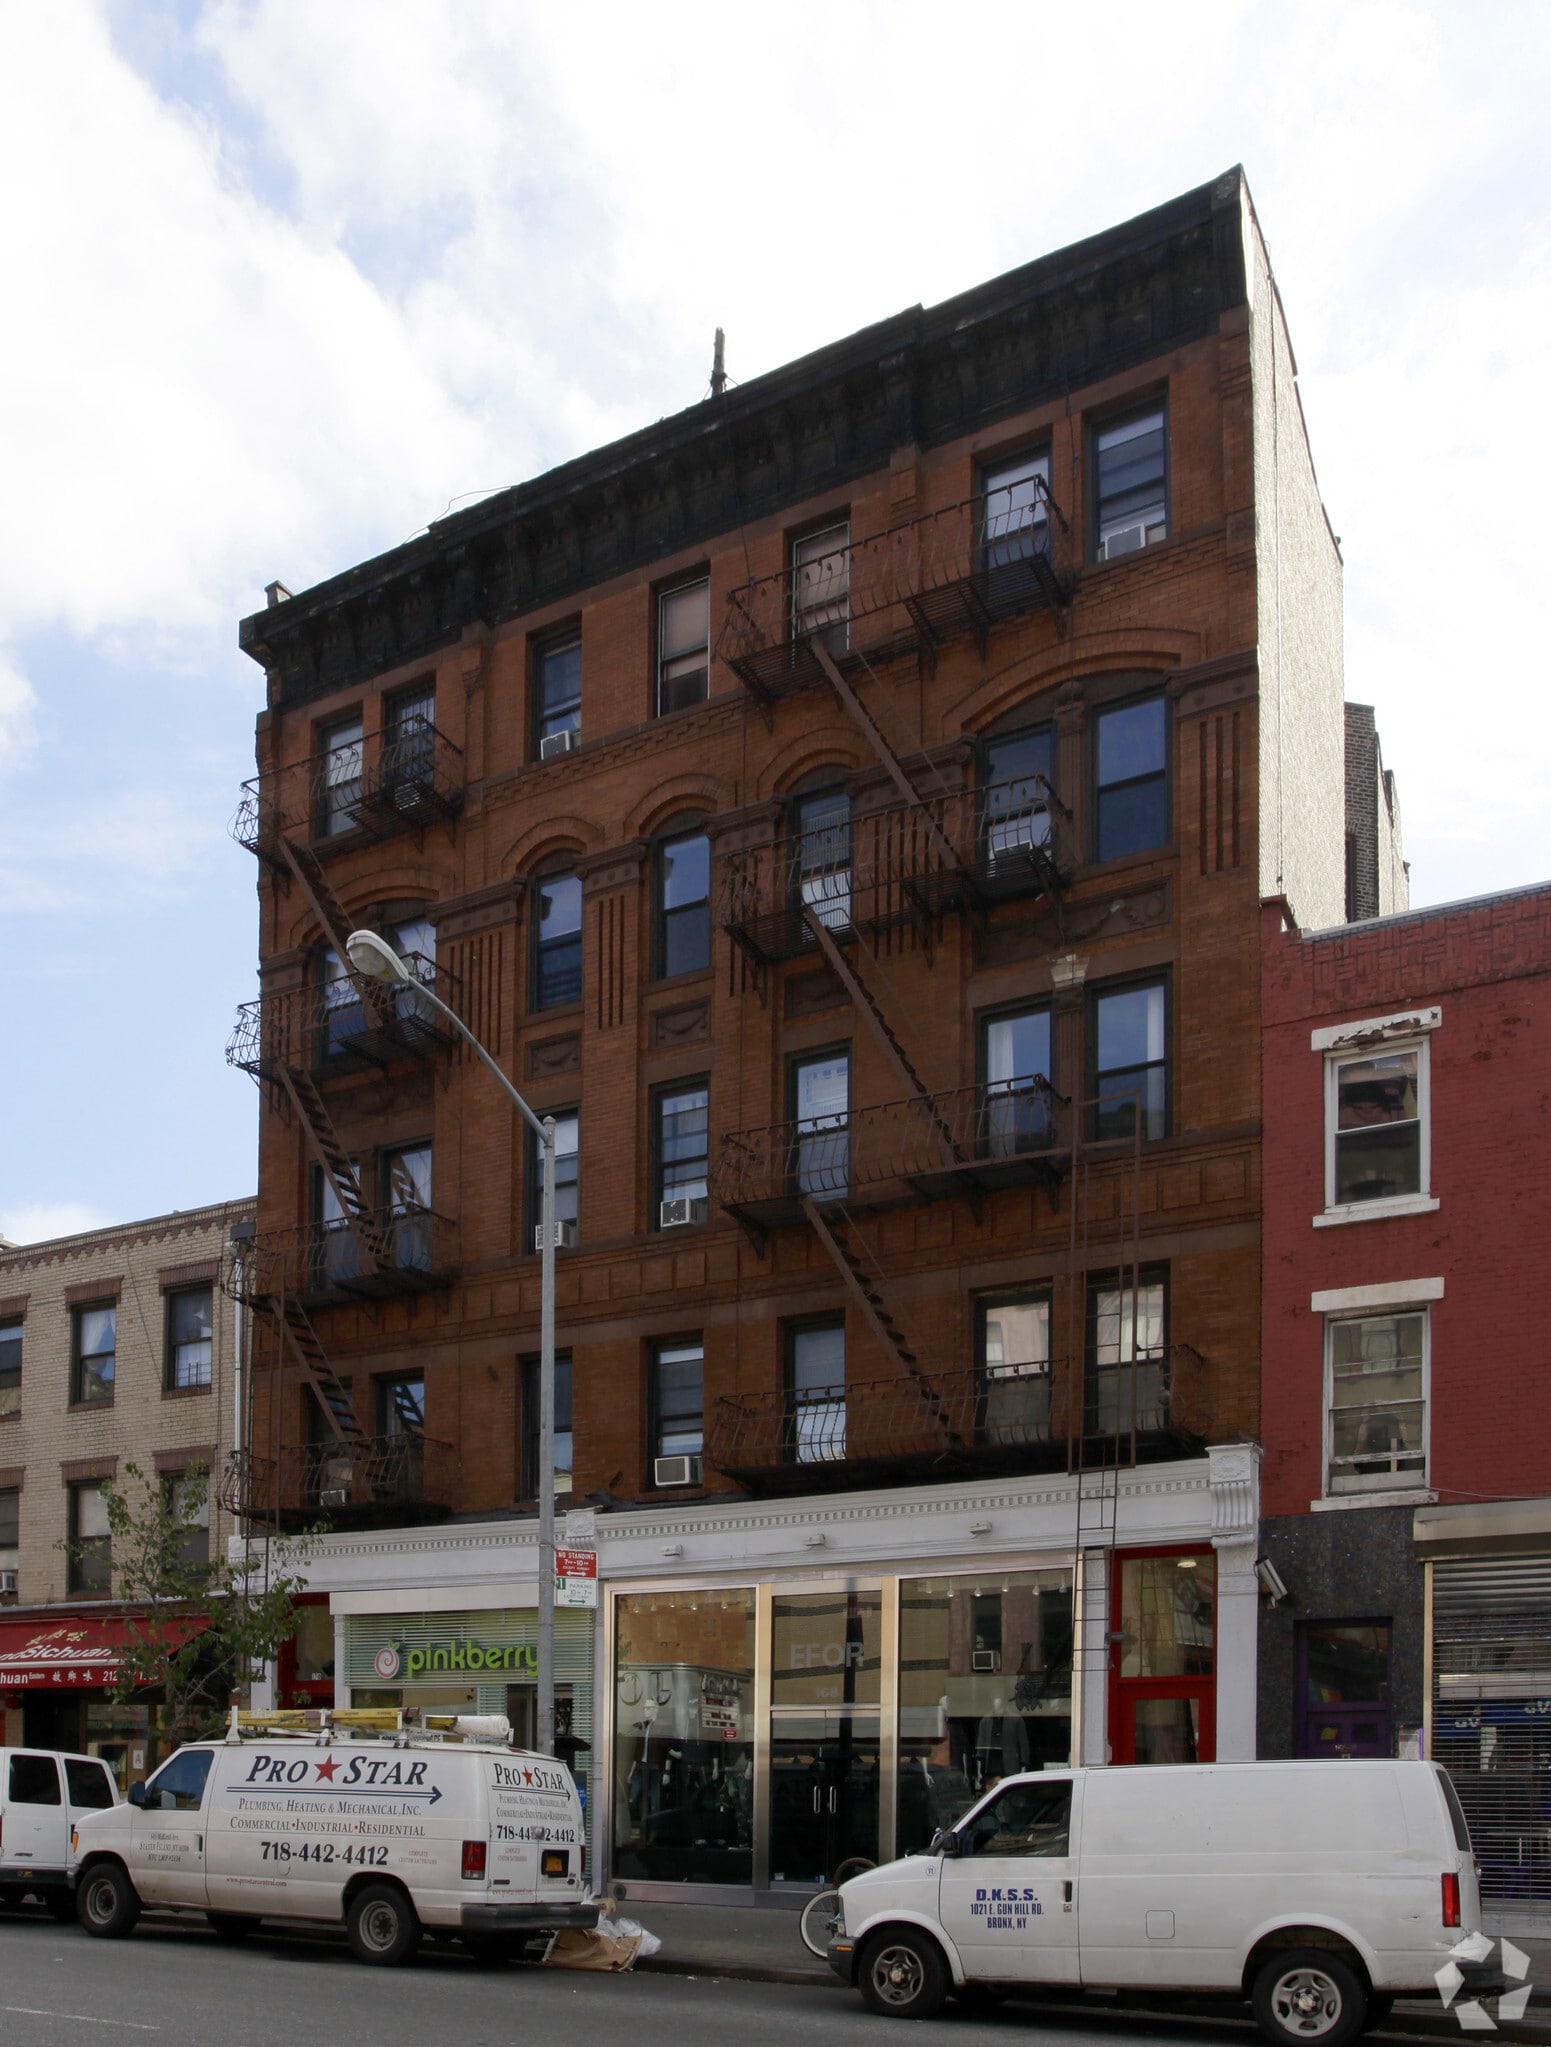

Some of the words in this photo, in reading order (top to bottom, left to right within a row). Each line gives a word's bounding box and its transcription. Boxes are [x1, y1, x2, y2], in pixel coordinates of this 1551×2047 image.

[568, 1552, 594, 1560] STANDING
[407, 1639, 539, 1679] pinkberry
[790, 1643, 864, 1668] EFOR
[245, 1755, 309, 1783] PRO
[342, 1755, 428, 1786] STAR
[493, 1762, 522, 1786] PRO
[533, 1766, 565, 1790] STAR
[286, 1799, 326, 1813] HEATING
[261, 1841, 389, 1866] 718-442-4412
[975, 1888, 1038, 1902] D.K.S.S.
[970, 1903, 987, 1915] 1021
[989, 1903, 996, 1915] E.
[997, 1903, 1013, 1915] GUN
[1014, 1903, 1030, 1915] HILL
[1031, 1903, 1044, 1915] RD.
[987, 1916, 1015, 1929] BRONX,
[1016, 1916, 1027, 1929] NY
